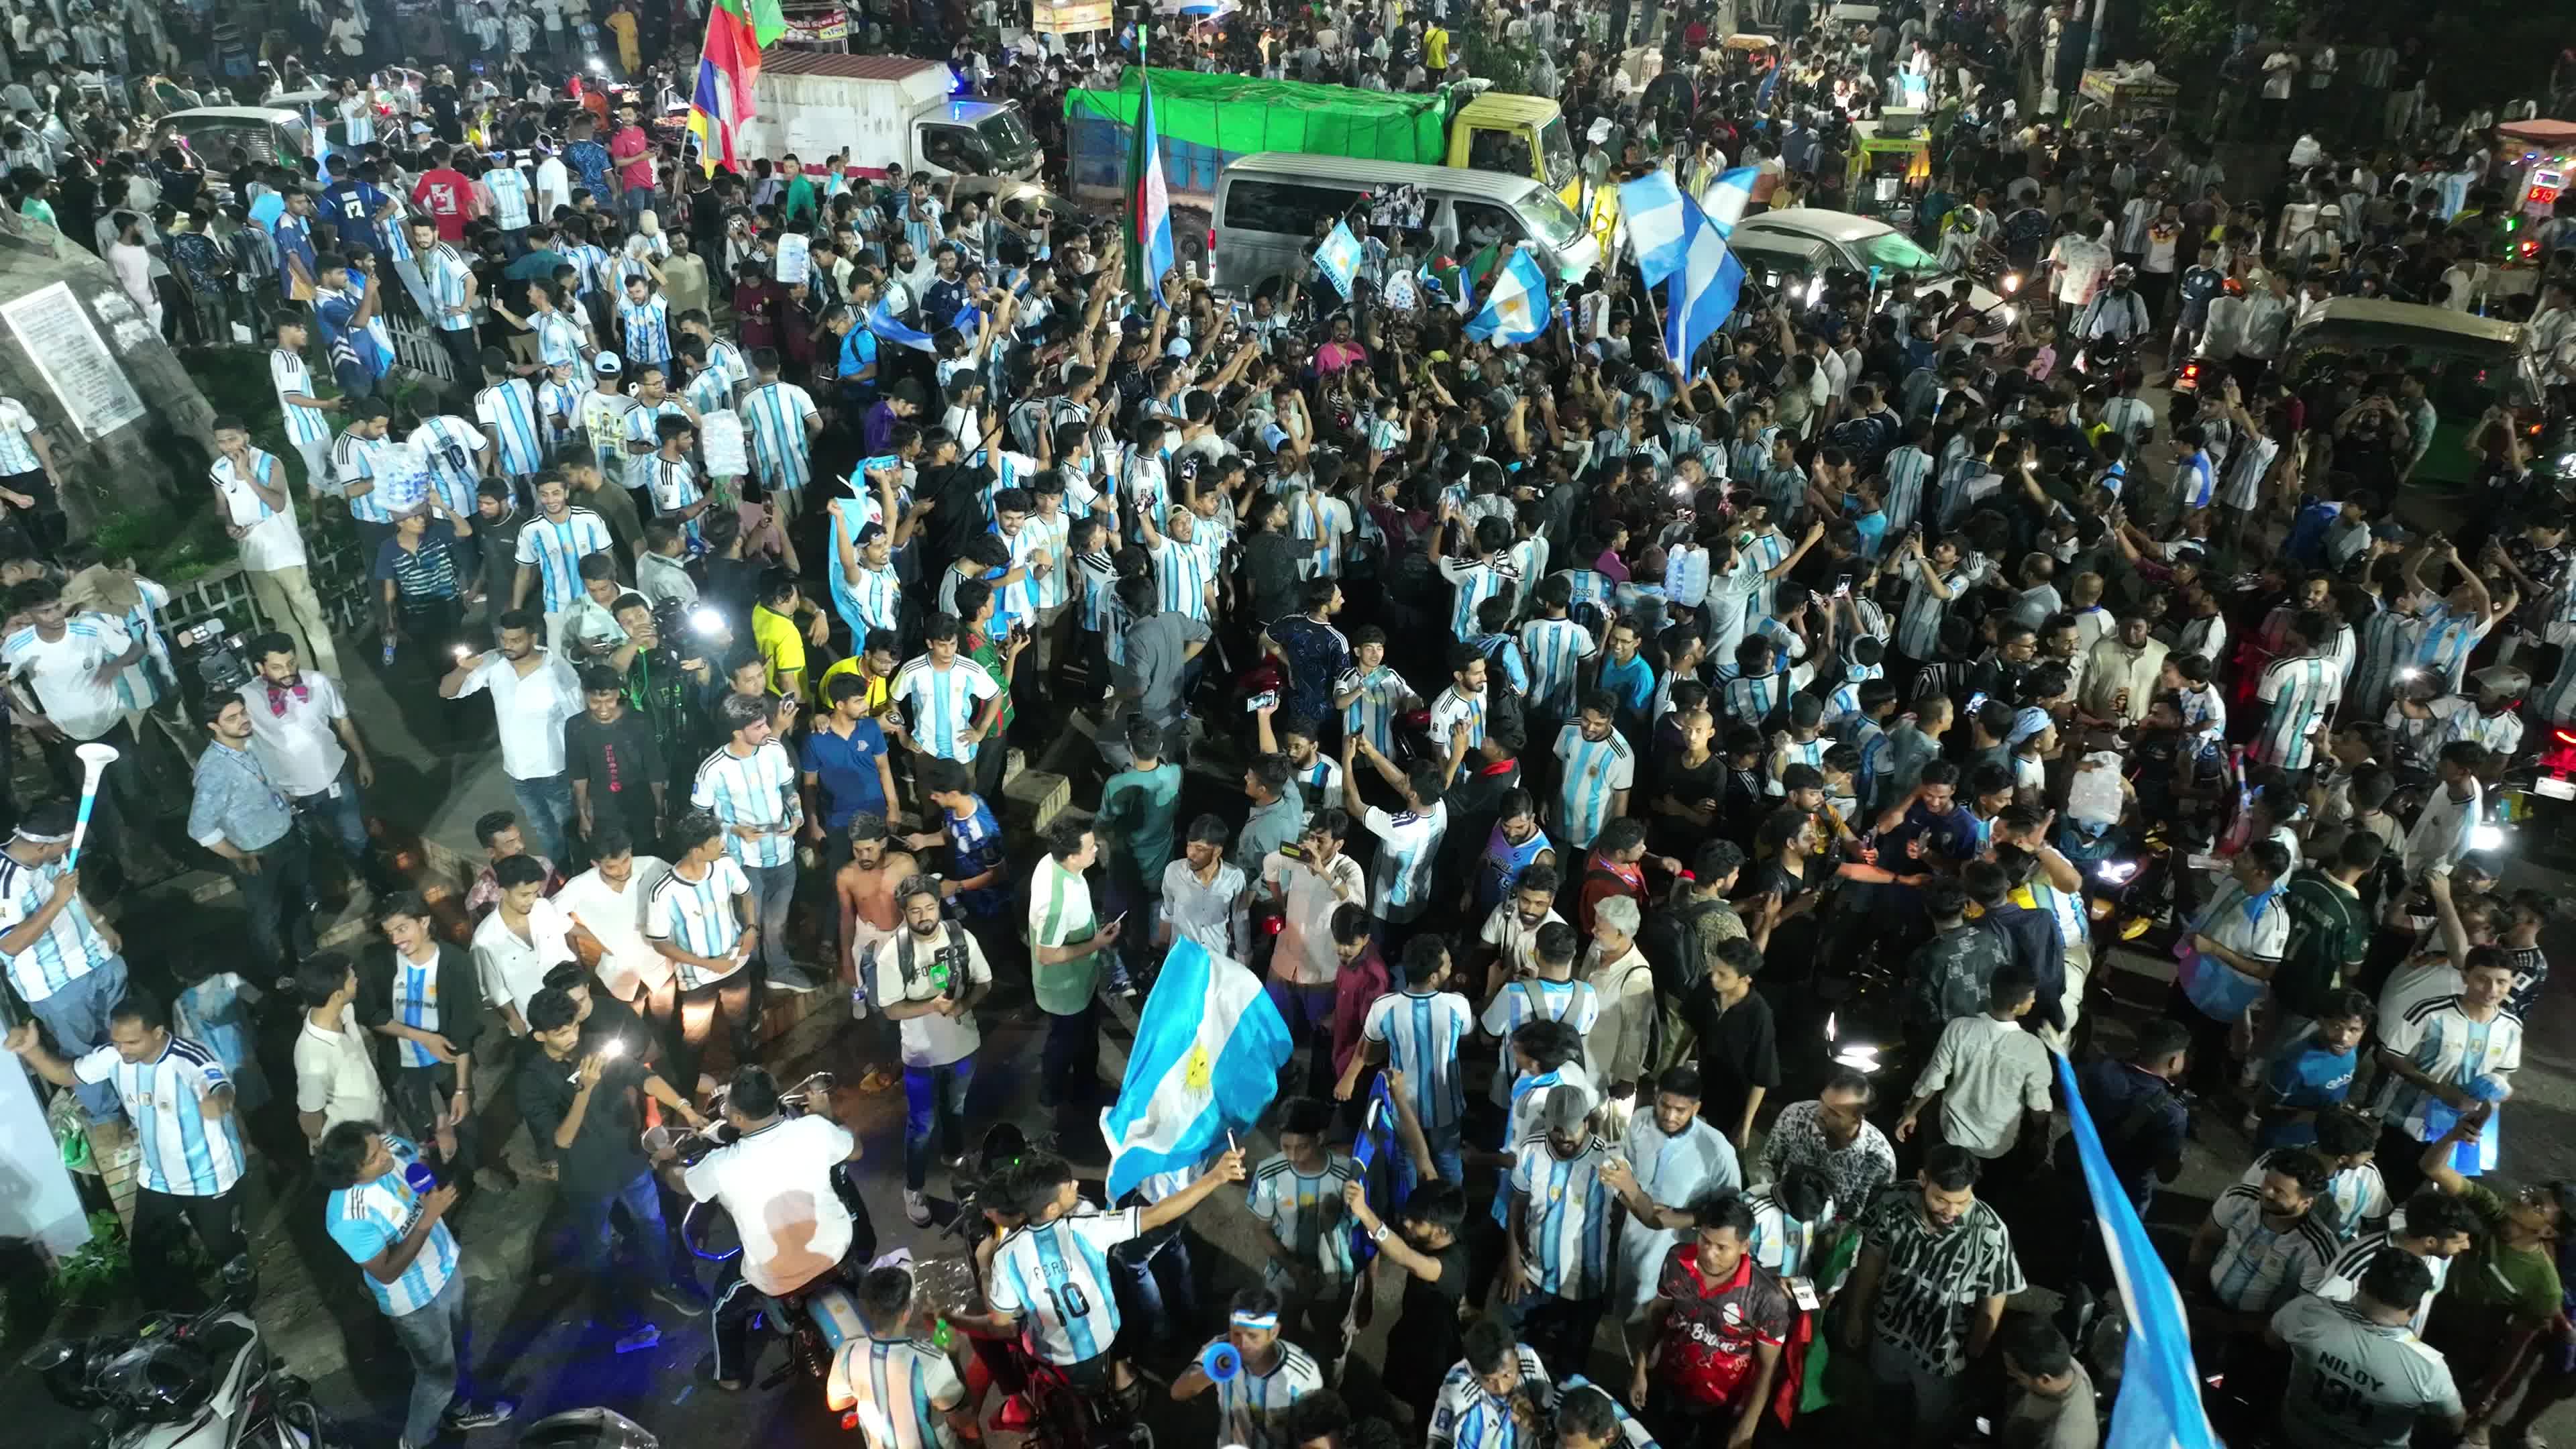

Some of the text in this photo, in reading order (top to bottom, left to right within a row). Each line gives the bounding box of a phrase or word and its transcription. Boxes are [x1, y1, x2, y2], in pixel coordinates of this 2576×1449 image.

[441, 444, 467, 473] 10
[1043, 1281, 1090, 1327] 10
[2317, 1350, 2385, 1393] NILOY
